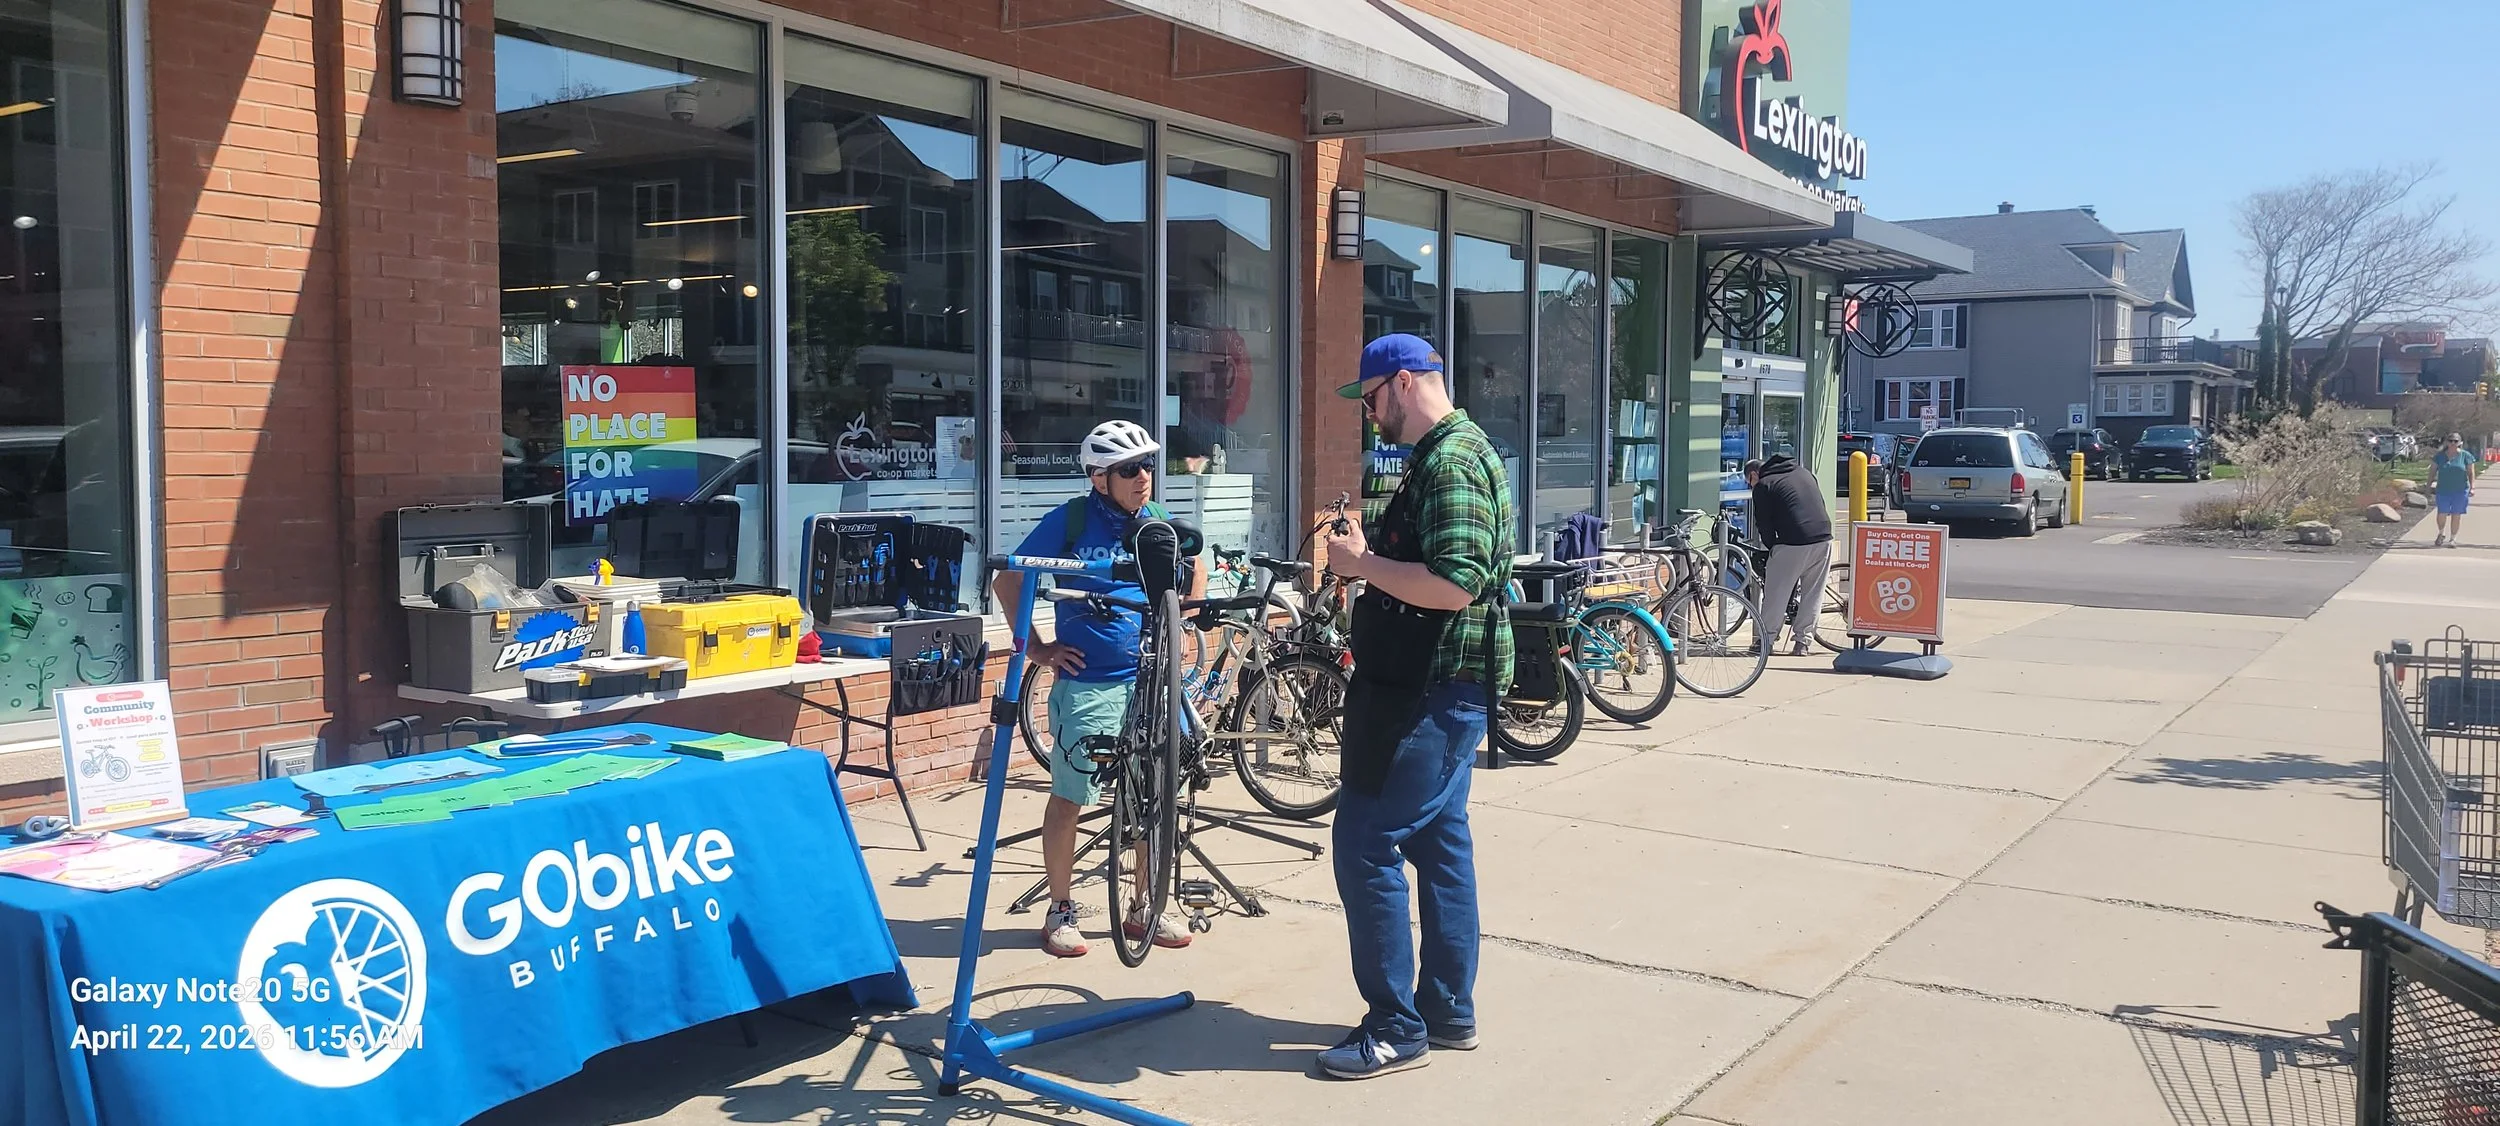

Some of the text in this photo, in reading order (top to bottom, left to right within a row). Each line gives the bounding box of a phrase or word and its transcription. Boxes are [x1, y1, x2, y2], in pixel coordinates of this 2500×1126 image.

[1754, 77, 1867, 180] Lexington
[568, 374, 617, 402] NO
[569, 412, 666, 441] PLACE
[571, 451, 634, 480] FOR
[850, 443, 937, 468] Lexington
[1012, 453, 1051, 466] Seasonal,
[1052, 453, 1075, 466] Local,
[1374, 457, 1403, 474] HATE
[1865, 538, 1930, 562] FREE
[1877, 577, 1912, 598] BO
[1880, 595, 1916, 614] GO
[494, 629, 570, 671] Park
[83, 701, 155, 715] Community
[89, 714, 154, 728] Workshop
[509, 897, 720, 989] BUFFALO
